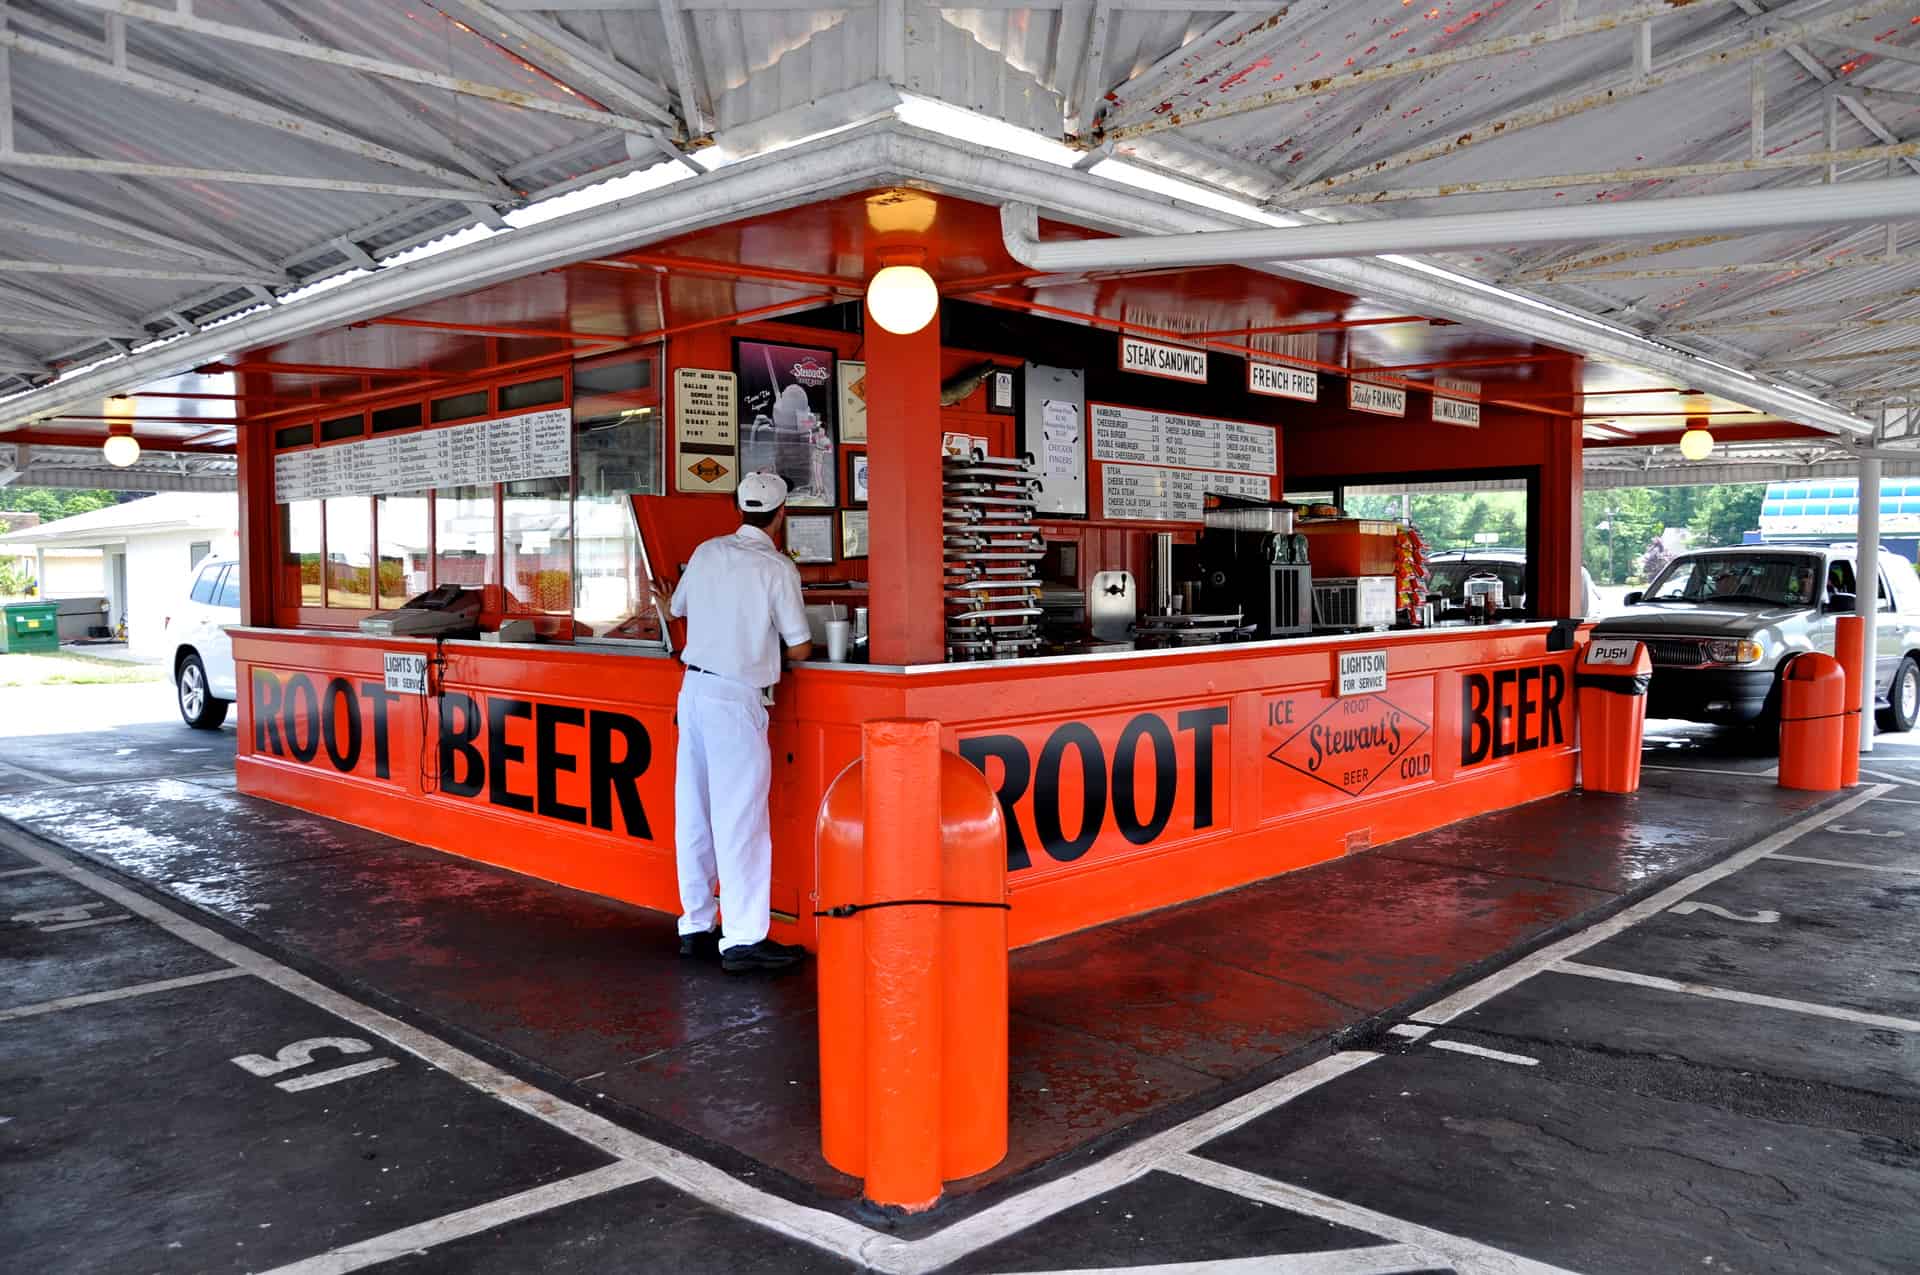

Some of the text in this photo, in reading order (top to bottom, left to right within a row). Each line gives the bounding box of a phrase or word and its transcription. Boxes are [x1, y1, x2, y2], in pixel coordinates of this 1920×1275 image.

[1126, 345, 1204, 376] STEAK SANDWICH
[1253, 367, 1315, 394] FRENCH FRIES
[1372, 390, 1403, 410] FRANKS
[1096, 408, 1121, 417] HAMBURGER
[1097, 418, 1128, 429] CHEESEBURGER
[1165, 416, 1200, 427] CALIFORNIA BURGER
[1097, 429, 1126, 439] PIZZA BURGER
[1192, 429, 1206, 438] BURGER
[1097, 439, 1138, 450] DOUBLE HAMBURGER
[1165, 436, 1174, 444] HOT
[1048, 443, 1072, 453] CHICKEN
[1097, 449, 1113, 458] DOUBLE
[1048, 455, 1072, 465] FINGERS
[1166, 456, 1177, 464] PIZZA
[1107, 466, 1121, 475] STEAK
[1107, 477, 1138, 487] CHEESE STEAK
[1107, 487, 1135, 497] PIZZA STEAK
[1107, 497, 1124, 506] CHEESE
[1138, 499, 1152, 508] STEAK
[1595, 647, 1627, 658] PUSH
[385, 655, 411, 673] LIGHTS
[1341, 654, 1385, 675] LIGHTS ON
[1343, 676, 1383, 691] FOR SERVICE
[1343, 699, 1369, 715] ROOT
[1268, 700, 1294, 726] ICE
[1461, 664, 1565, 767] BEER
[253, 668, 654, 840] ROOT BEER
[1400, 753, 1431, 780] COLD
[1343, 768, 1369, 786] BEER
[958, 705, 1229, 873] ROOT
[1667, 901, 1782, 923] 2
